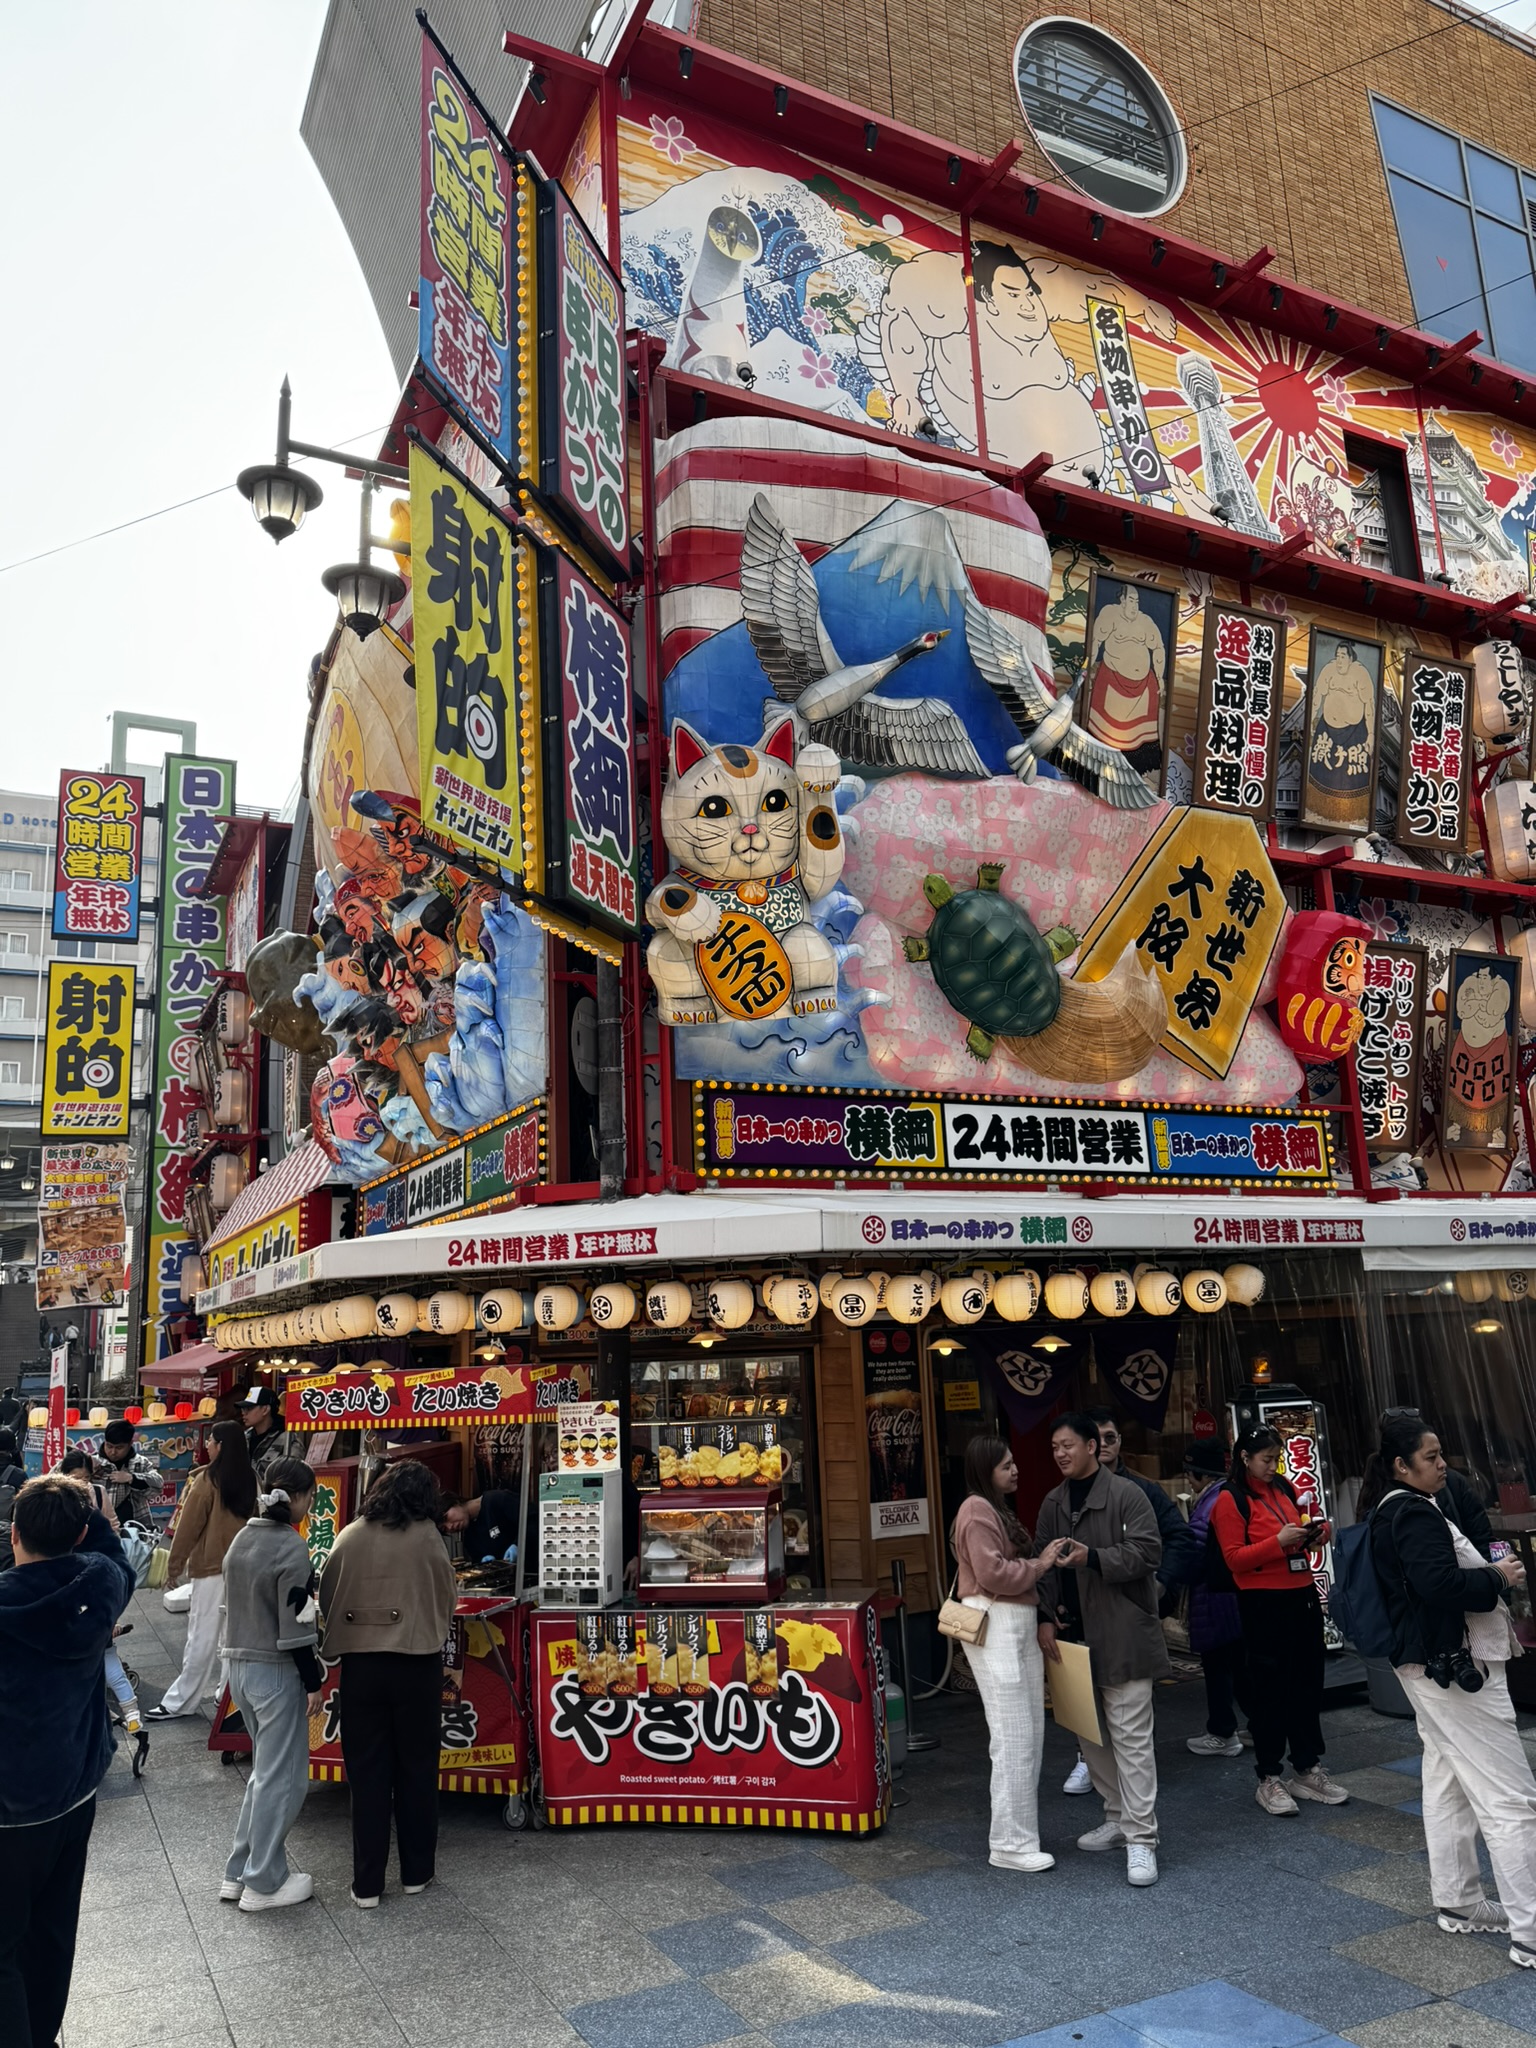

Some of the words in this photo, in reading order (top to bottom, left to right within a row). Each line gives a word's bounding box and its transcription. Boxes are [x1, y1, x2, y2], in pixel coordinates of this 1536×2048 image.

[1096, 306, 1160, 482] 名物串かつ
[426, 484, 506, 790] 射的
[564, 580, 634, 864] 横綱
[1206, 616, 1251, 805] 逸品料理
[1243, 625, 1275, 806] 料理長自慢の
[1407, 666, 1444, 834] 名物串かつ
[1438, 672, 1465, 839] 横綱定番の一品
[65, 777, 136, 820] 24
[432, 765, 511, 826] 新世界遊技場
[64, 818, 134, 851] 時間
[433, 793, 515, 862] チャンピオン
[64, 850, 133, 882] 営業
[568, 838, 635, 929] 通天閣店
[66, 906, 130, 932] 無休
[67, 883, 130, 908] 年中
[1136, 855, 1214, 973] 大阪
[1175, 868, 1266, 1031] 新世界
[55, 972, 127, 1098] 射的
[51, 1102, 123, 1114] 新世界遊技場
[51, 1113, 123, 1127] チャンピオン
[714, 1098, 735, 1159] 新世界
[736, 1114, 843, 1144] 日本一の串かつ
[846, 1106, 936, 1160] 横綱
[503, 1116, 539, 1185] 横綱
[952, 1113, 1145, 1164] 24時間営業
[1153, 1118, 1171, 1169] 新世界
[1171, 1133, 1249, 1157] 日本一の串かつ
[1251, 1123, 1324, 1171] 横綱
[408, 1157, 464, 1218] 24時間営業
[448, 1234, 571, 1267] 24時間営業
[578, 1232, 655, 1257] 年中無休
[890, 1218, 1015, 1241] 日本一の串かつ
[1019, 1215, 1068, 1245] 横綱
[1193, 1217, 1300, 1244] 24時間営業
[1306, 1220, 1362, 1241] 年中無休
[301, 1387, 391, 1419] やきいも
[411, 1382, 502, 1413] たい焼き
[559, 1416, 598, 1428] やきいも
[872, 1439, 892, 1447] ZERO
[893, 1437, 920, 1446] SUGAR
[879, 1505, 909, 1514] WELCOME
[880, 1513, 920, 1526] OSAKA
[586, 1615, 598, 1663] 紅はるか
[616, 1615, 628, 1663] 紅はるか
[656, 1614, 668, 1680] シルクスイート
[687, 1614, 699, 1680] シルクスイート
[755, 1614, 768, 1651] 安納芋
[551, 1670, 842, 1766] やきいも
[620, 1775, 652, 1783] Roasted
